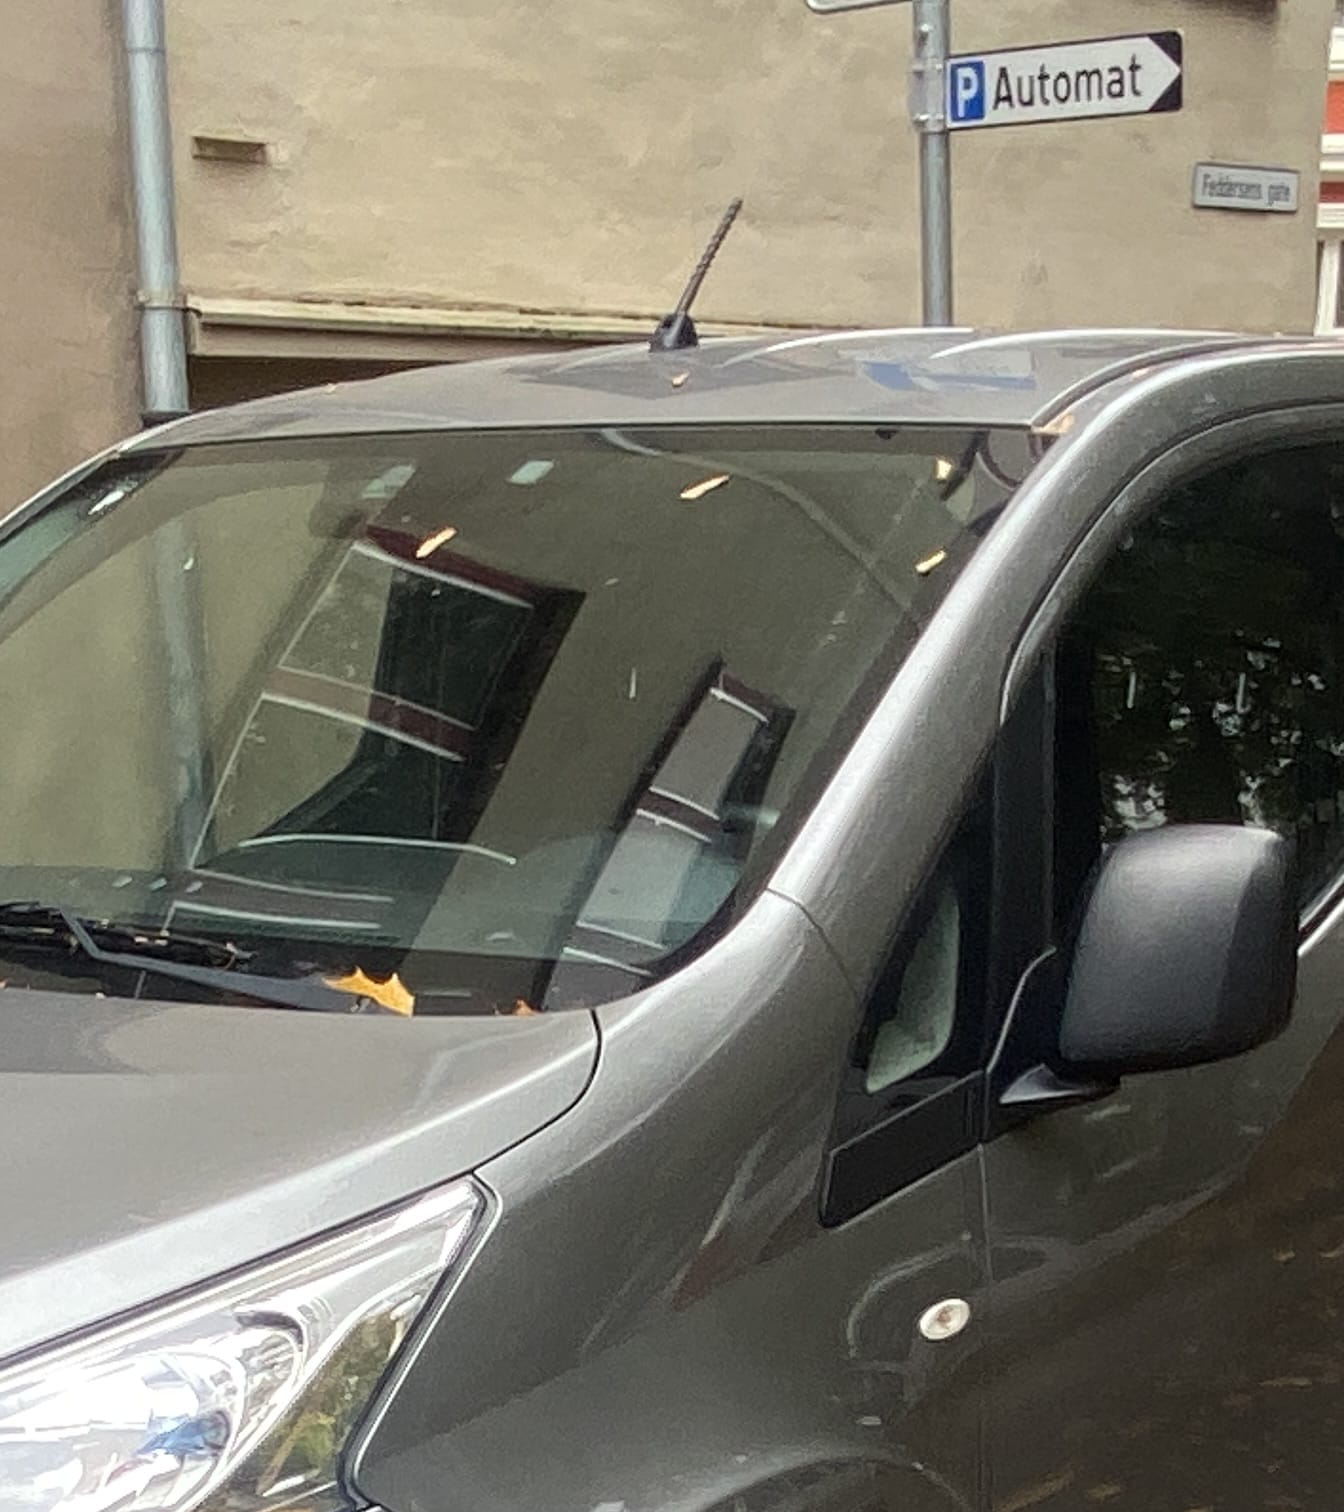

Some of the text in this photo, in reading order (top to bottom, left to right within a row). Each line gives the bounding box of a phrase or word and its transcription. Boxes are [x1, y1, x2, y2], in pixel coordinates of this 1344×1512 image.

[957, 55, 1143, 118] P Automat
[1267, 182, 1291, 207] gate
